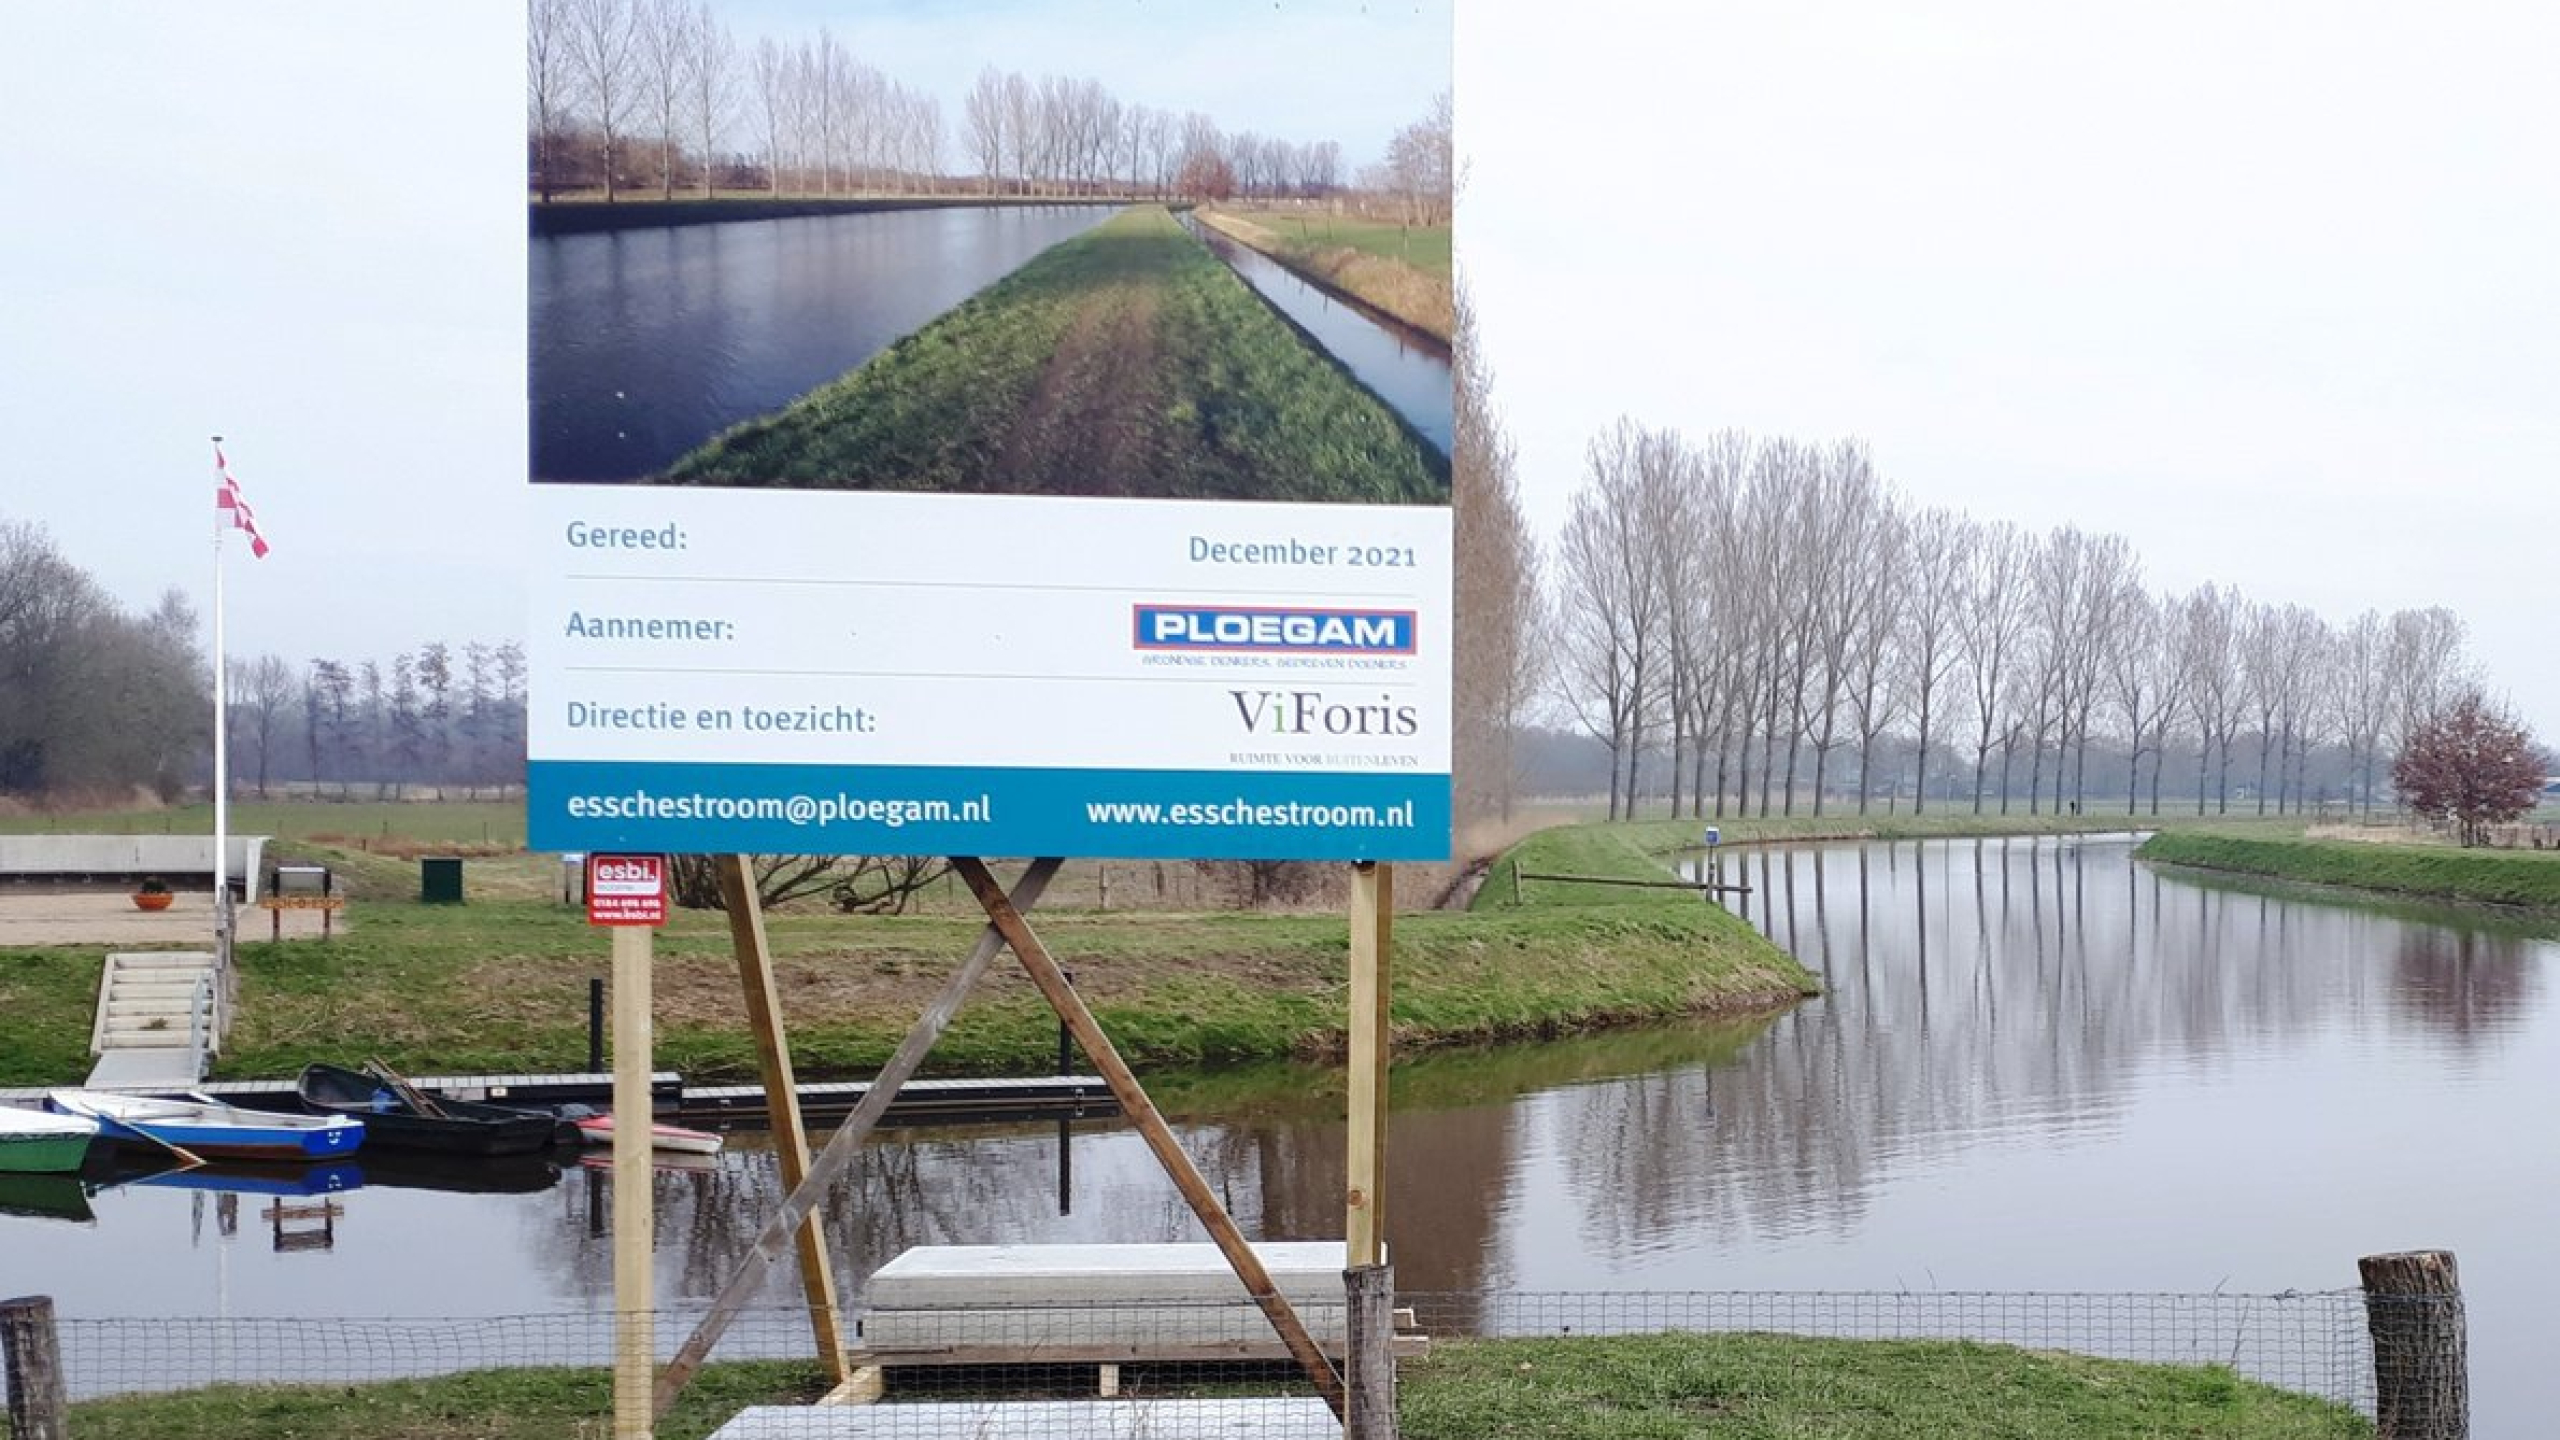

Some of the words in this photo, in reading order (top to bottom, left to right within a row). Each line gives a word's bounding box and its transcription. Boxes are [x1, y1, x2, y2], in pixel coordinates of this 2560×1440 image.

[566, 521, 687, 549] Gereed:
[1189, 536, 1338, 565] December
[1347, 547, 1416, 566] 2021
[566, 611, 734, 640] Aannemer:
[1154, 612, 1395, 646] PLOEGAM
[567, 701, 687, 728] Directie
[697, 707, 732, 729] en
[743, 704, 876, 733] toezicht:
[1228, 690, 1418, 735] ViForis
[567, 790, 991, 827] esschestroom@ploegam.nl
[1086, 798, 1414, 828] www.esschestroom.nl
